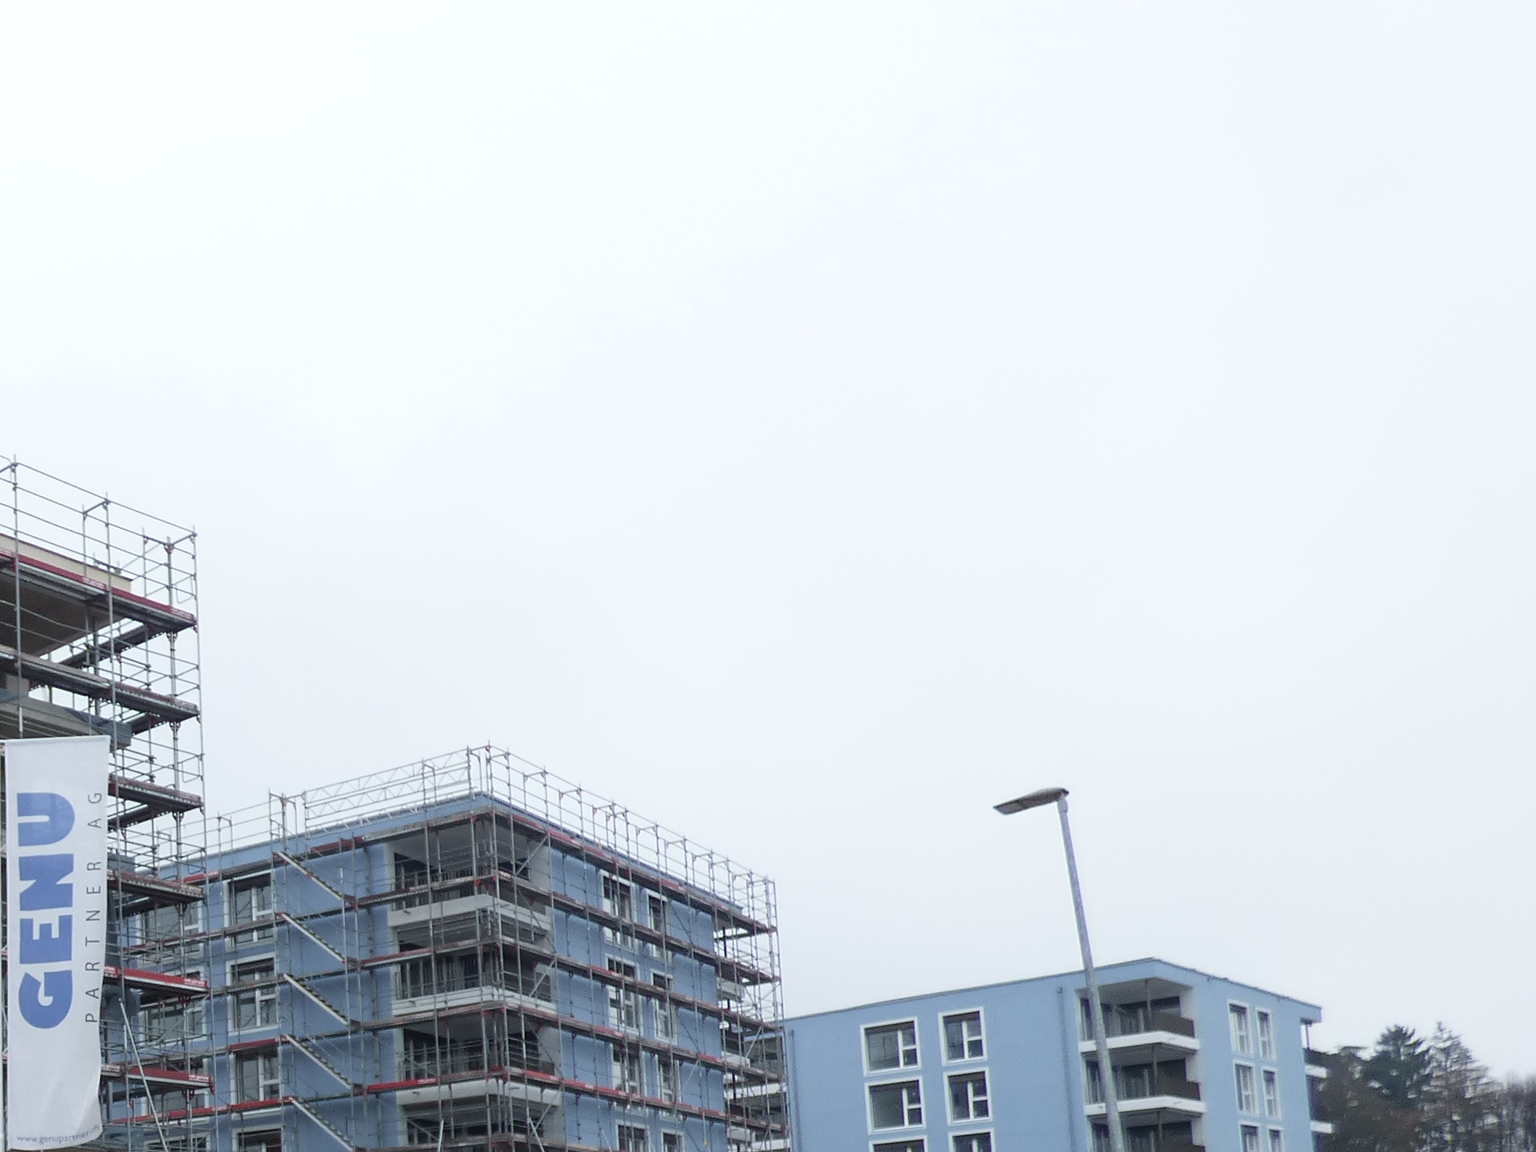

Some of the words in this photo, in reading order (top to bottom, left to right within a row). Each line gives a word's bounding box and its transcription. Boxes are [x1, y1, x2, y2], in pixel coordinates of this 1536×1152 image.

[87, 790, 103, 829] AG
[17, 792, 76, 1029] GENU
[84, 860, 102, 1024] PARTNER
